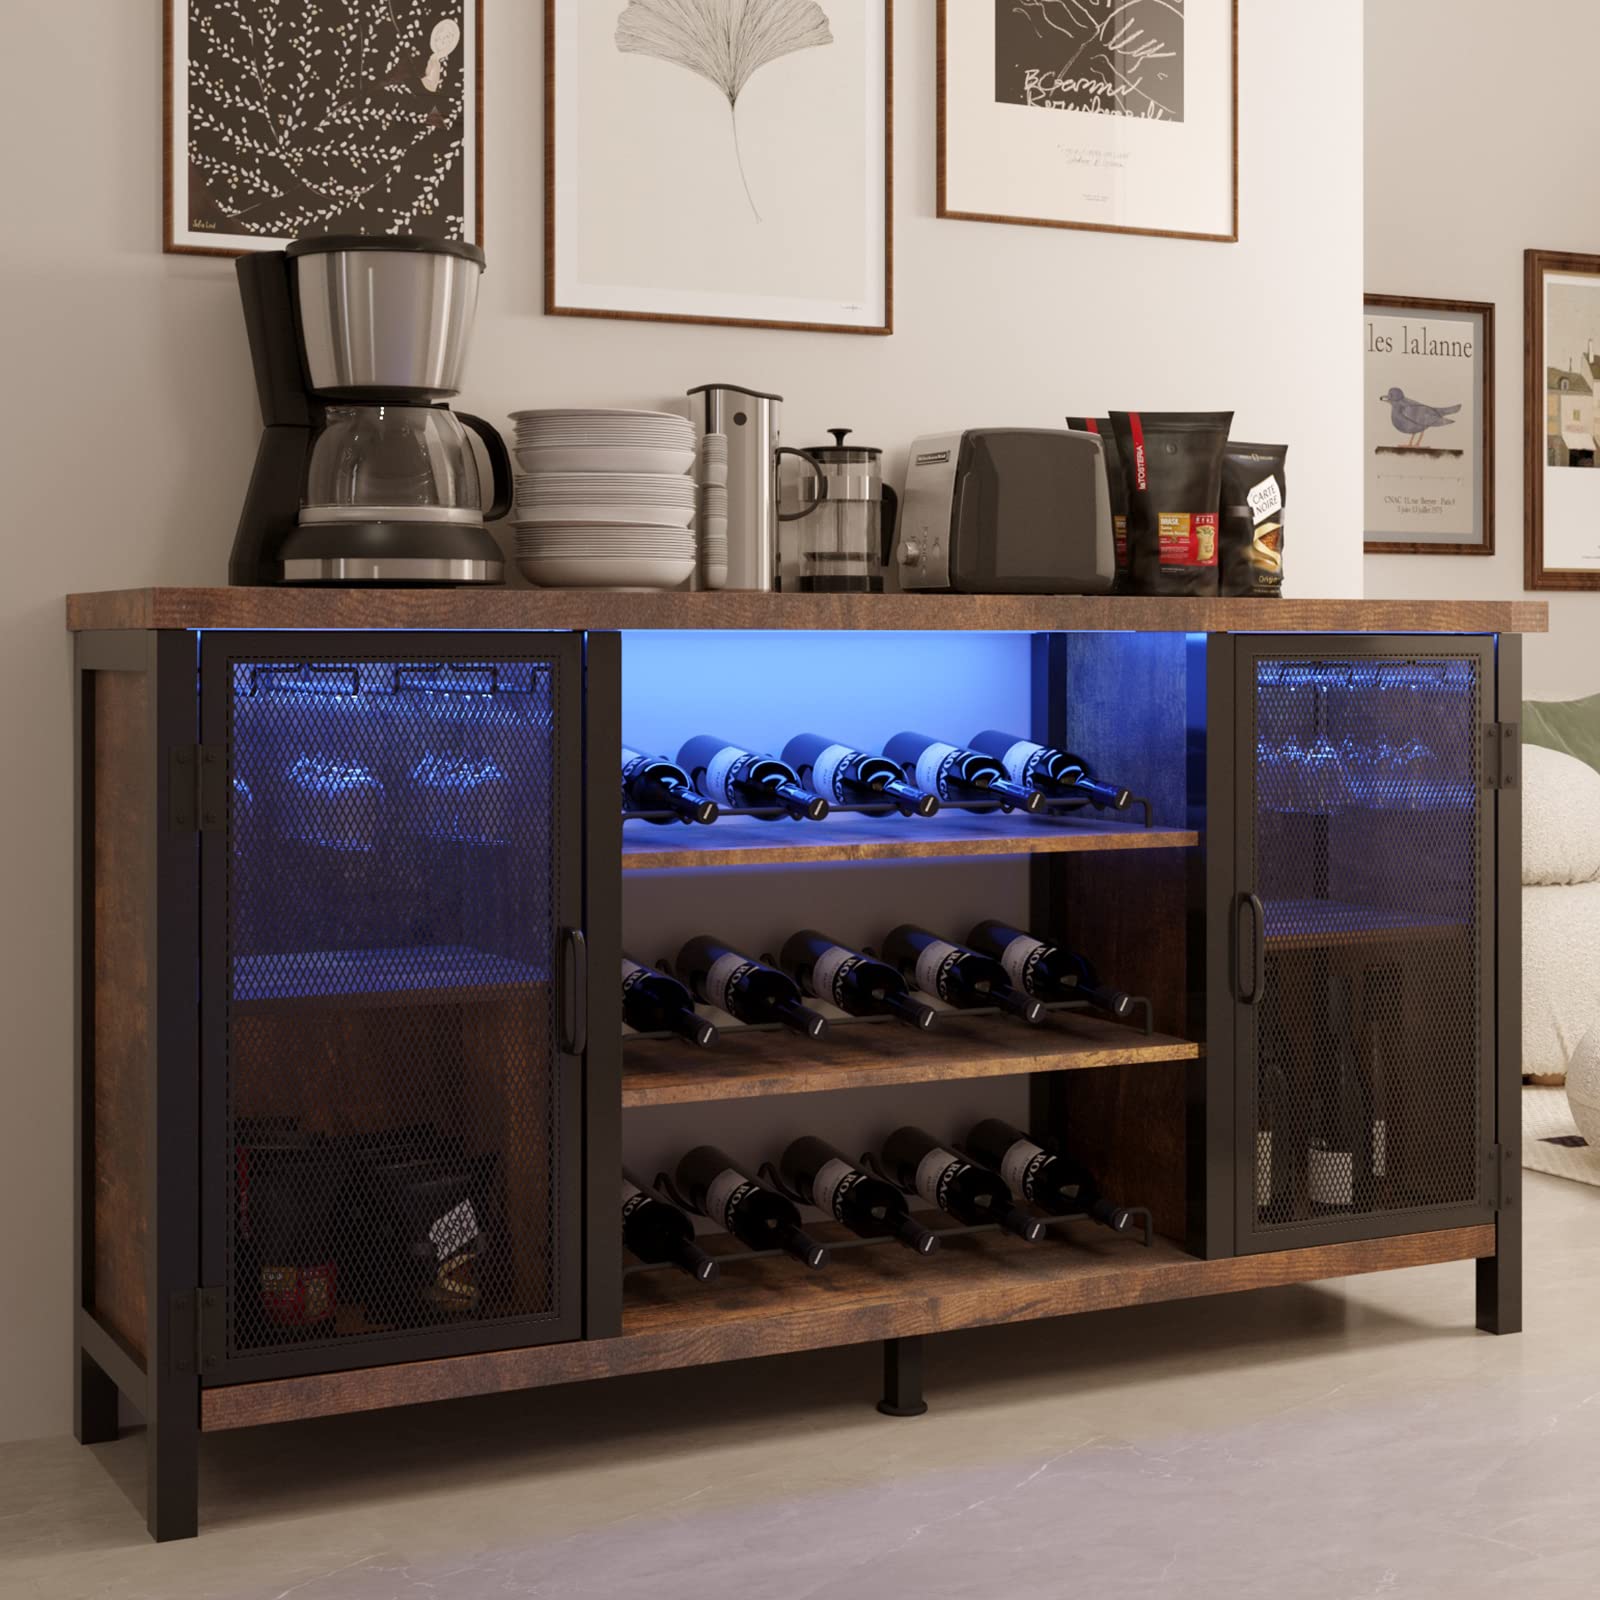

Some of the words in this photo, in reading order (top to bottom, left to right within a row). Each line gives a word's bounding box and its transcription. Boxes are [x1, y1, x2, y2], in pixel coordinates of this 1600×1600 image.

[1368, 323, 1393, 353] les
[1401, 325, 1473, 358] lalanne
[1252, 484, 1275, 505] CARTE
[1256, 495, 1278, 514] NOIRE
